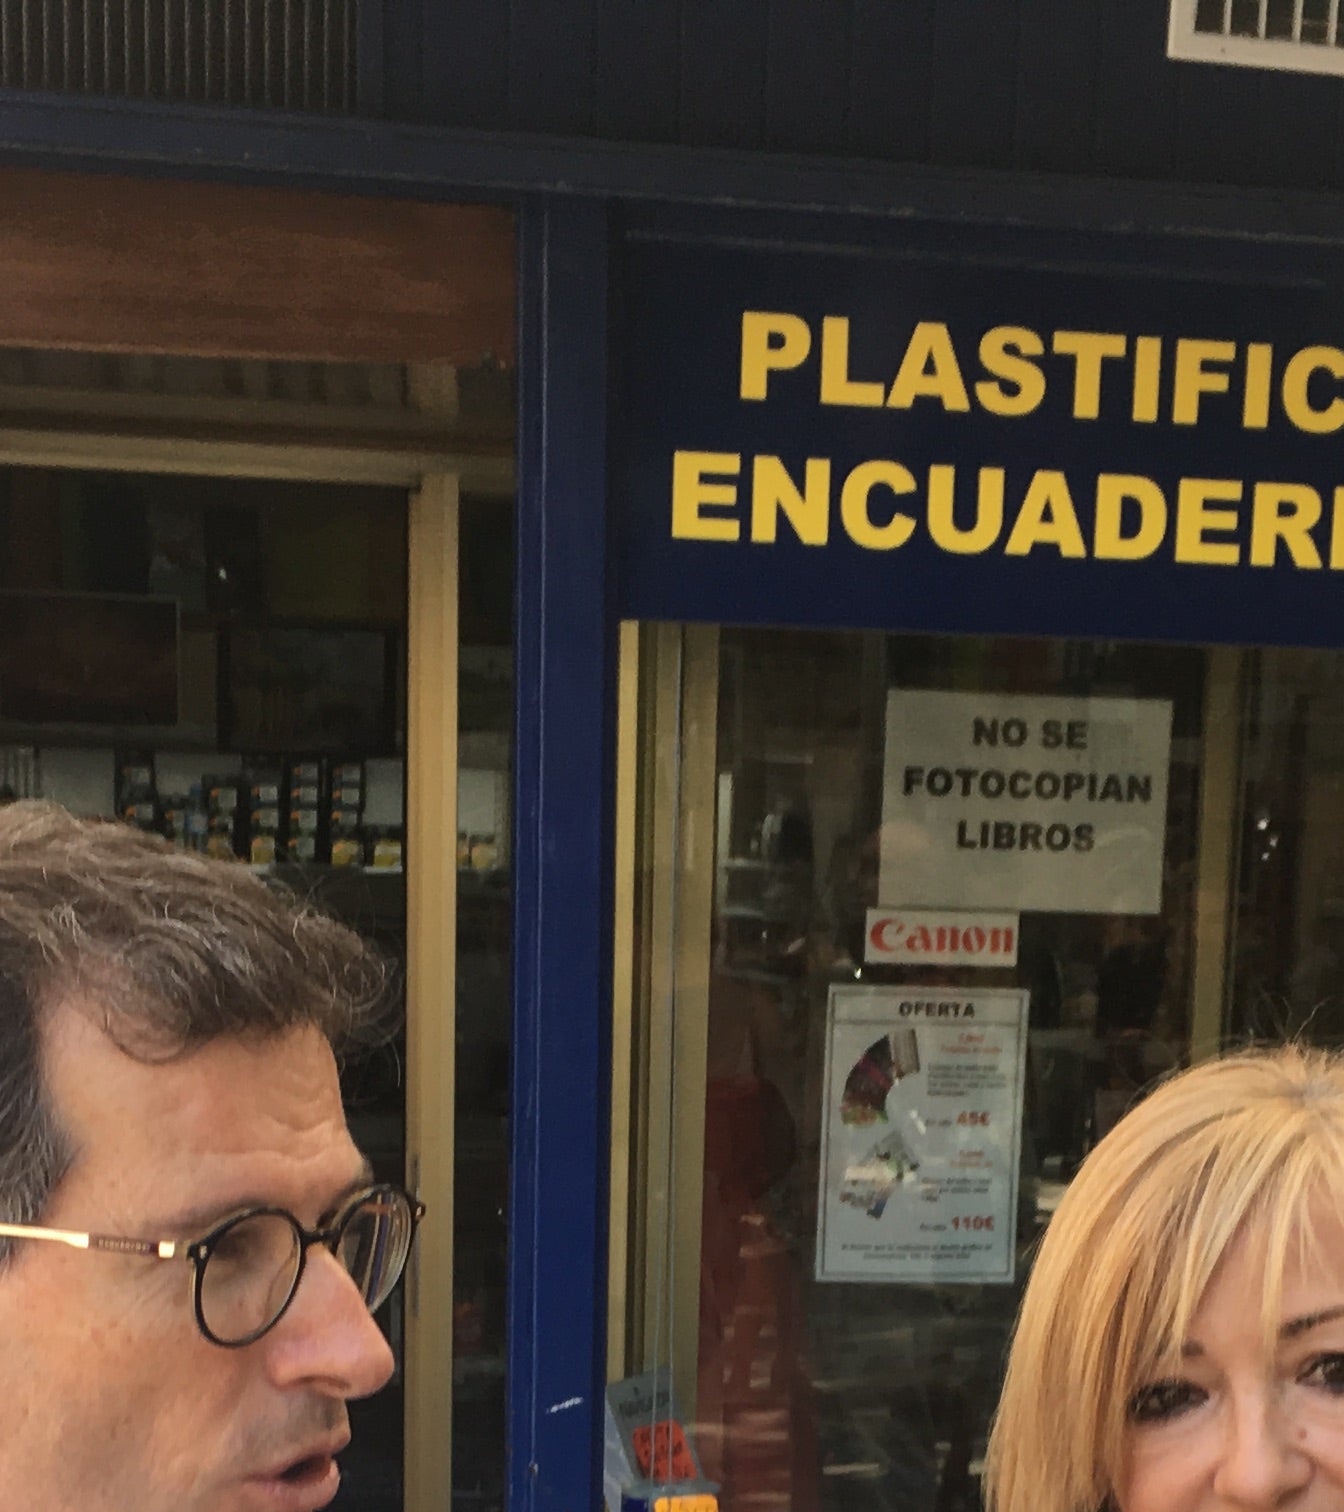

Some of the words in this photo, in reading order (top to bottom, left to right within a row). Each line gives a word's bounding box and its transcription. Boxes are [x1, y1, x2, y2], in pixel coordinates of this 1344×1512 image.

[972, 716, 1027, 747] NO
[1042, 719, 1089, 750] SE
[903, 765, 1152, 803] FOTOCOPIAN
[957, 820, 1094, 852] LIBROS
[870, 917, 1014, 953] Canon
[898, 1002, 975, 1018] OFERTA
